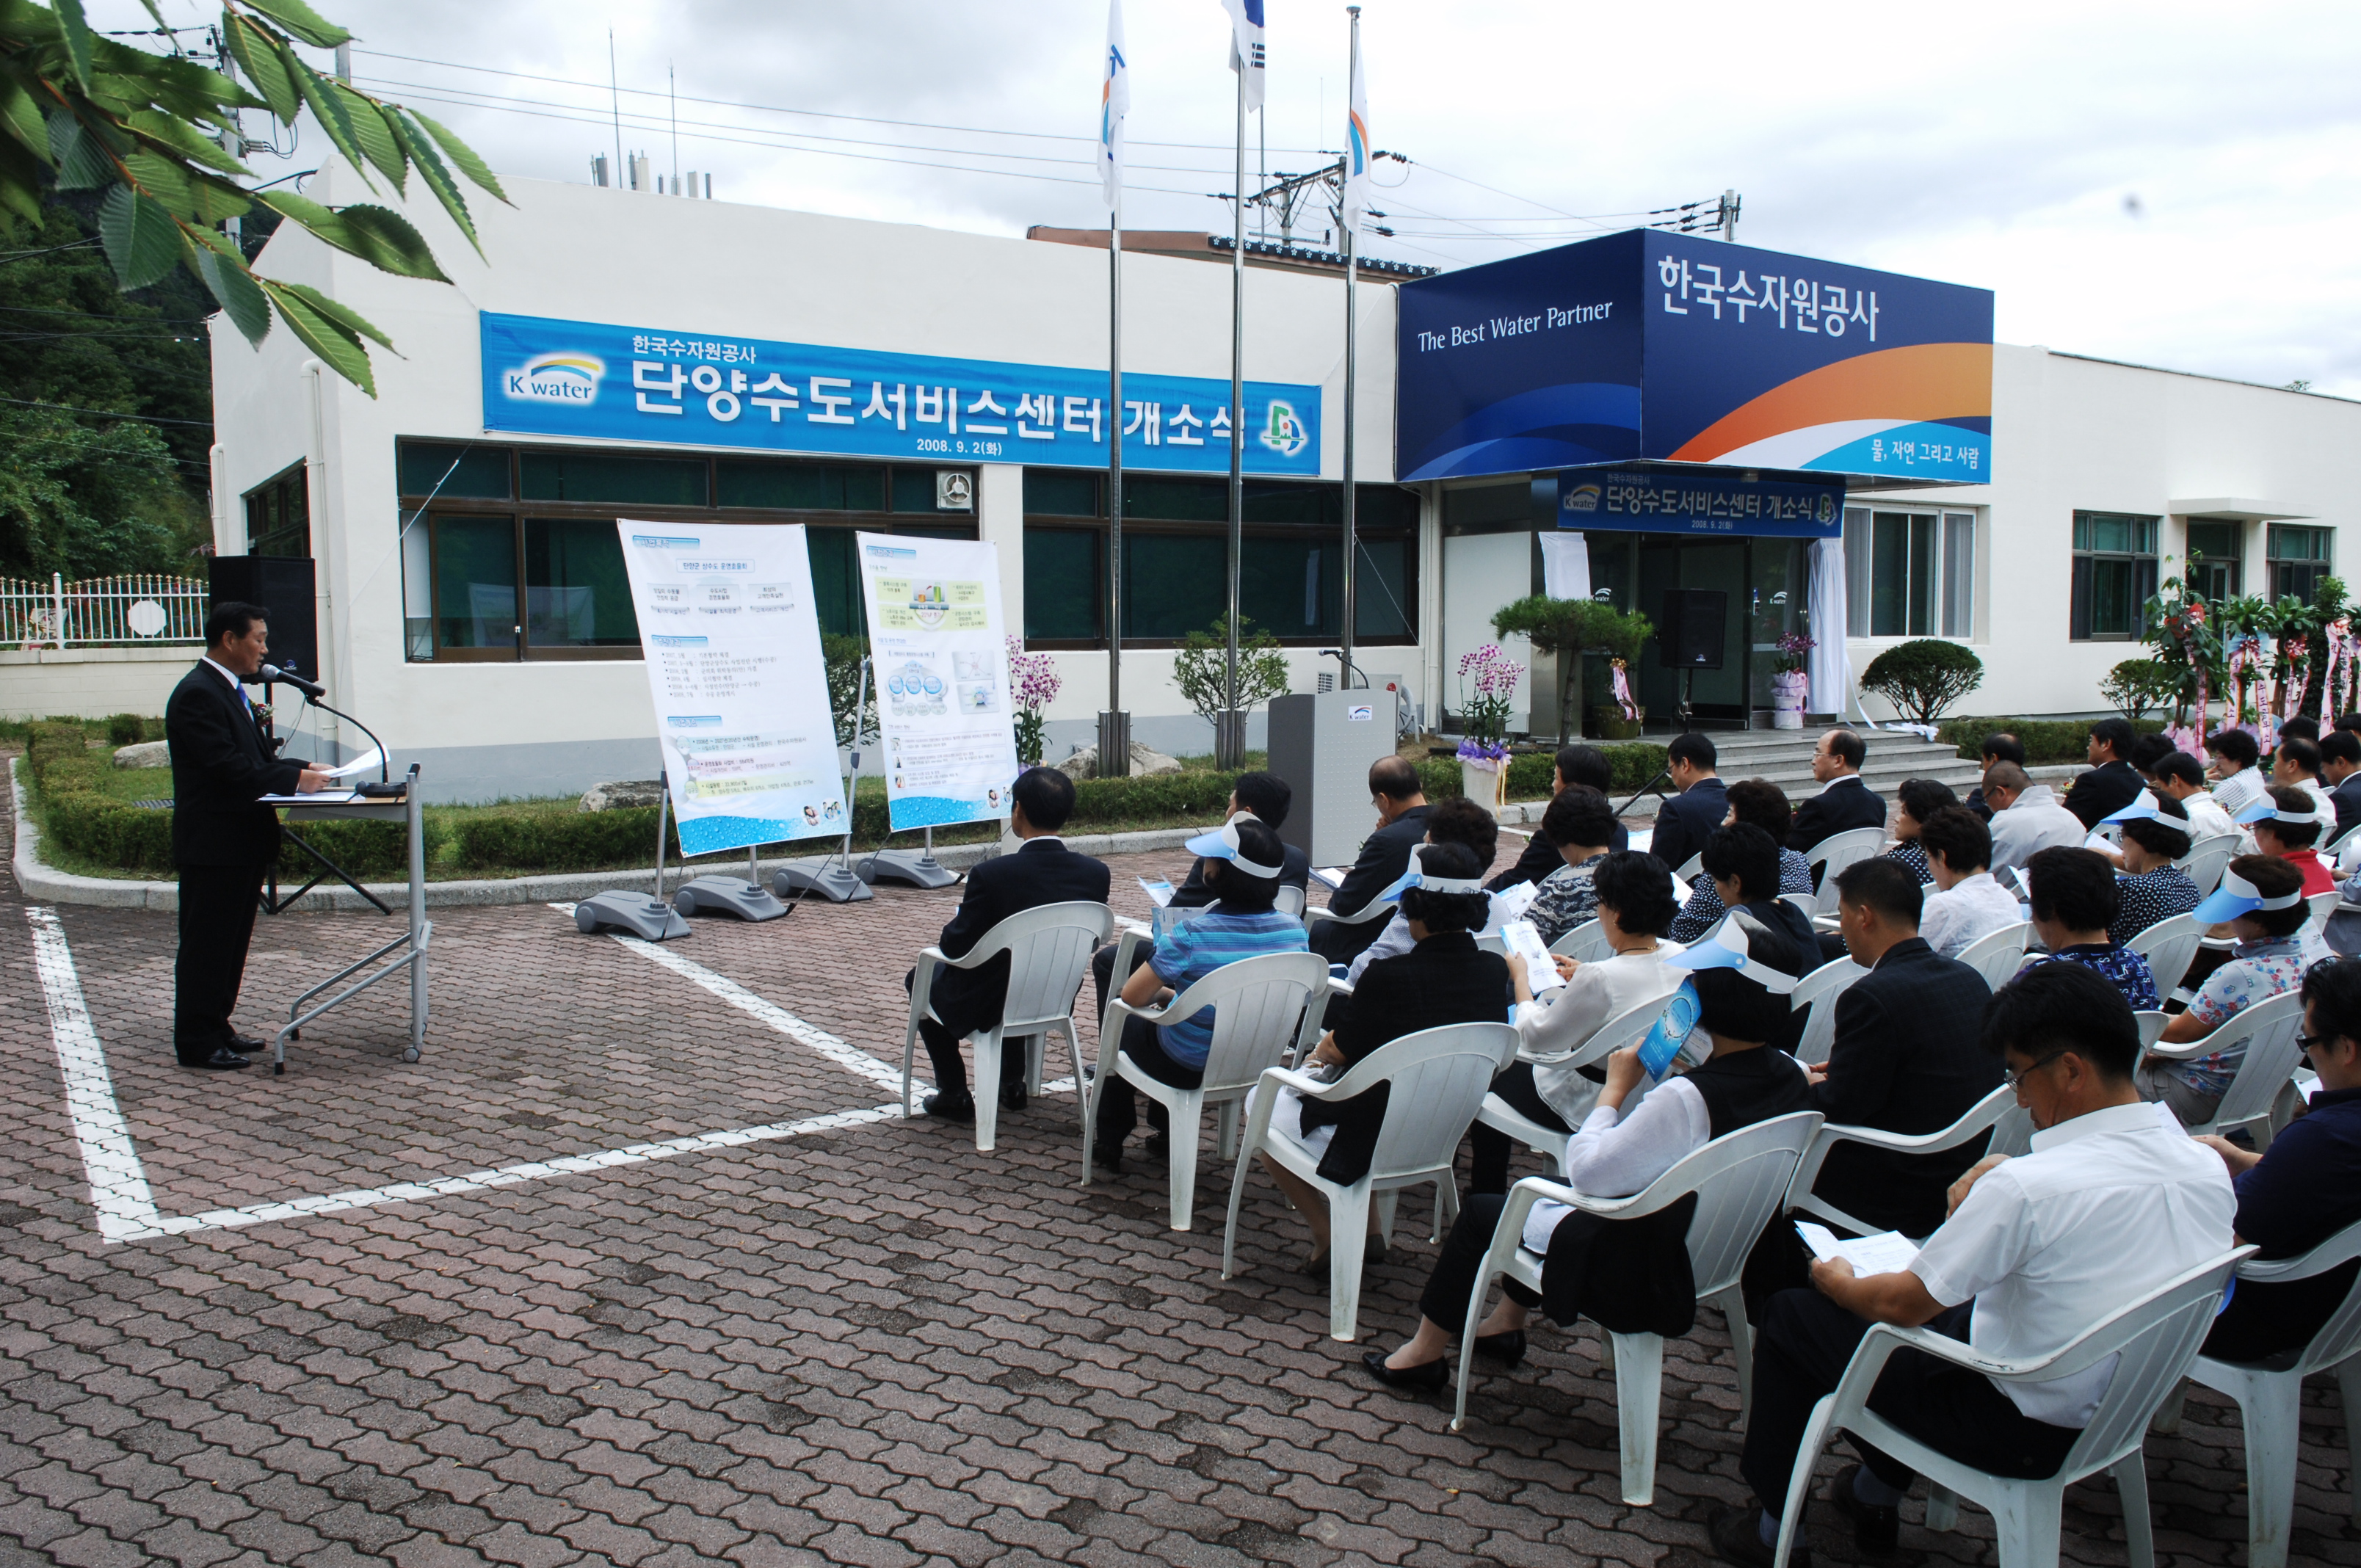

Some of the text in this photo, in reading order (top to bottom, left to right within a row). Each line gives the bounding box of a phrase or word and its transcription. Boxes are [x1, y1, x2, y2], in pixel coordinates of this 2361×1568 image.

[1658, 255, 1879, 342] 한국수자원공사
[1418, 302, 1613, 352] The Best Water Partner
[632, 335, 757, 365] 한국수자원공사
[510, 376, 593, 399] K water
[632, 360, 1245, 450] 단양수도서비스센터 개소식
[916, 438, 1003, 457] 2008. 9. 2(화)
[1871, 438, 1980, 470] 물, 자연 그리고 사람
[1607, 473, 1650, 485] 한국수자원공사
[1564, 497, 1596, 509] K water
[1606, 485, 1813, 520] 단양수도서비스센터 개소식
[1691, 520, 1709, 529] 2008.
